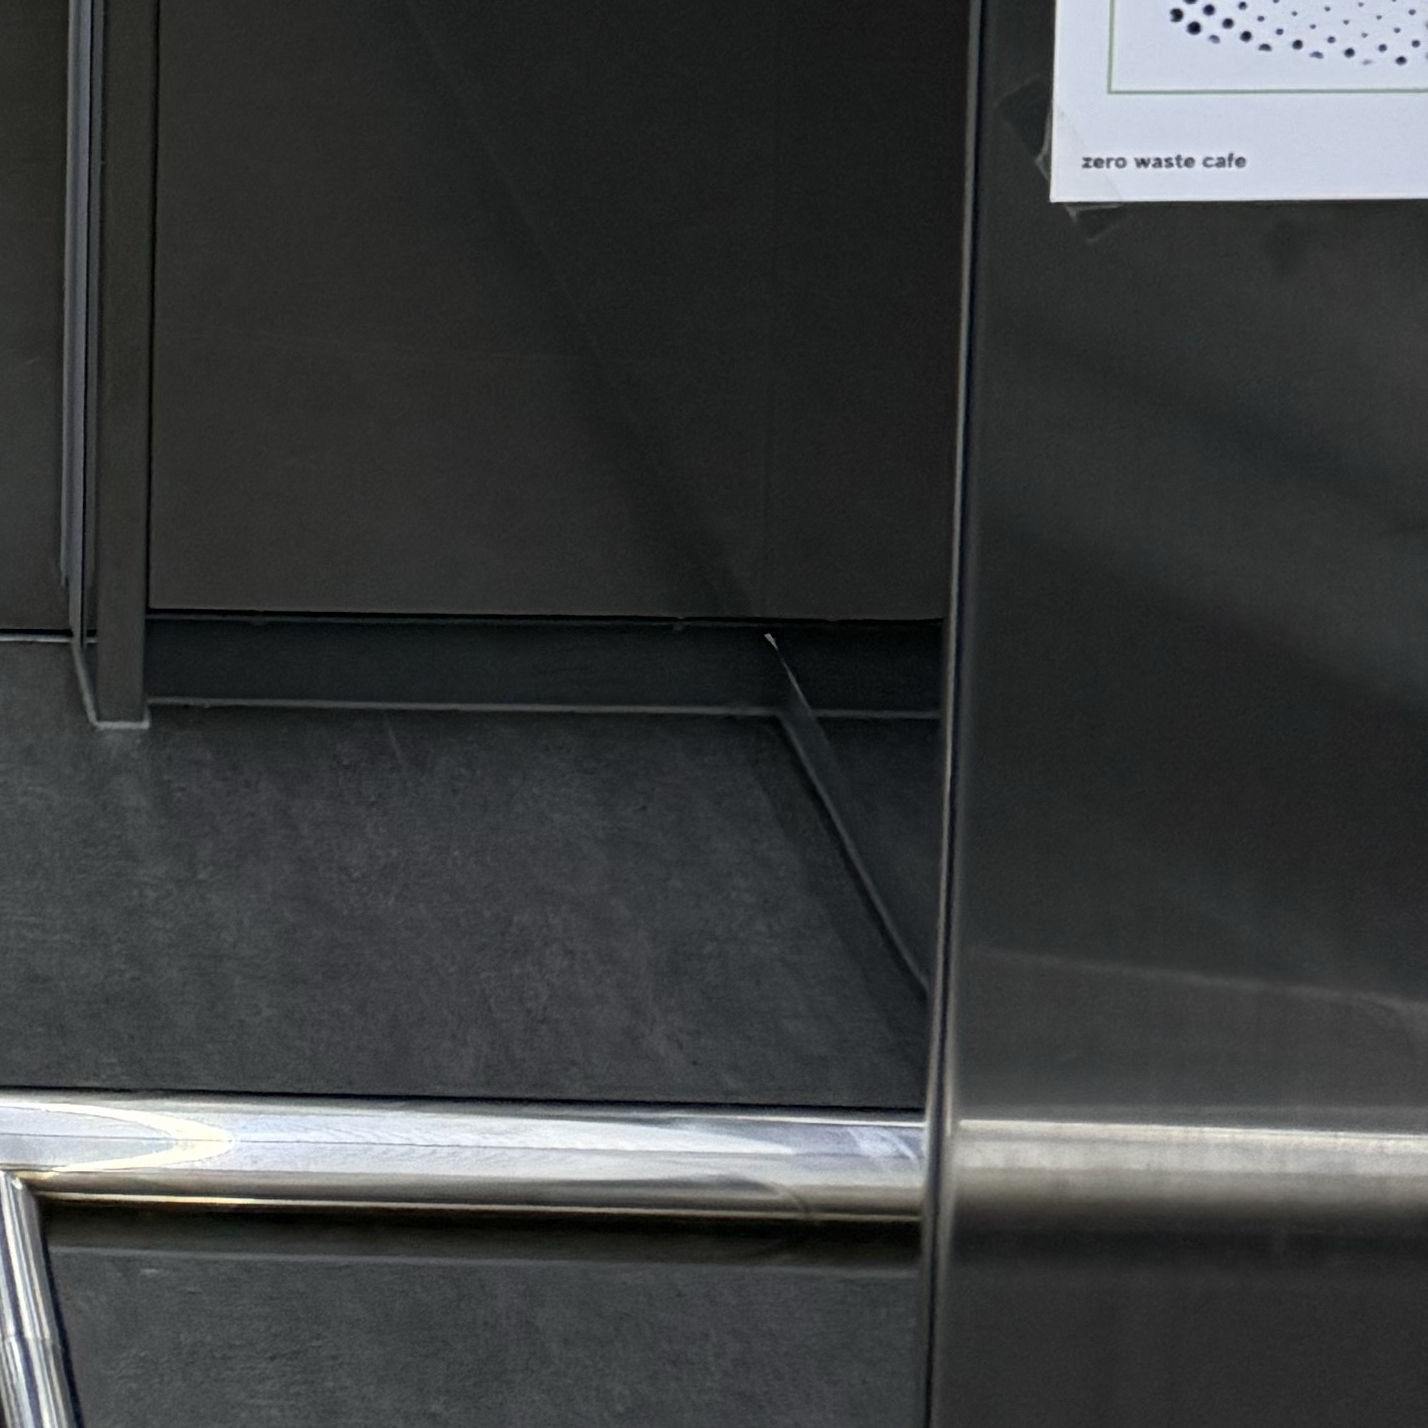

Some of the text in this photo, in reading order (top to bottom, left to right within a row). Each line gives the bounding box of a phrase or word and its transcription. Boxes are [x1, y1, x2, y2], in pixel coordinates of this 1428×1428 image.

[1081, 151, 1247, 169] zero waste cafe
